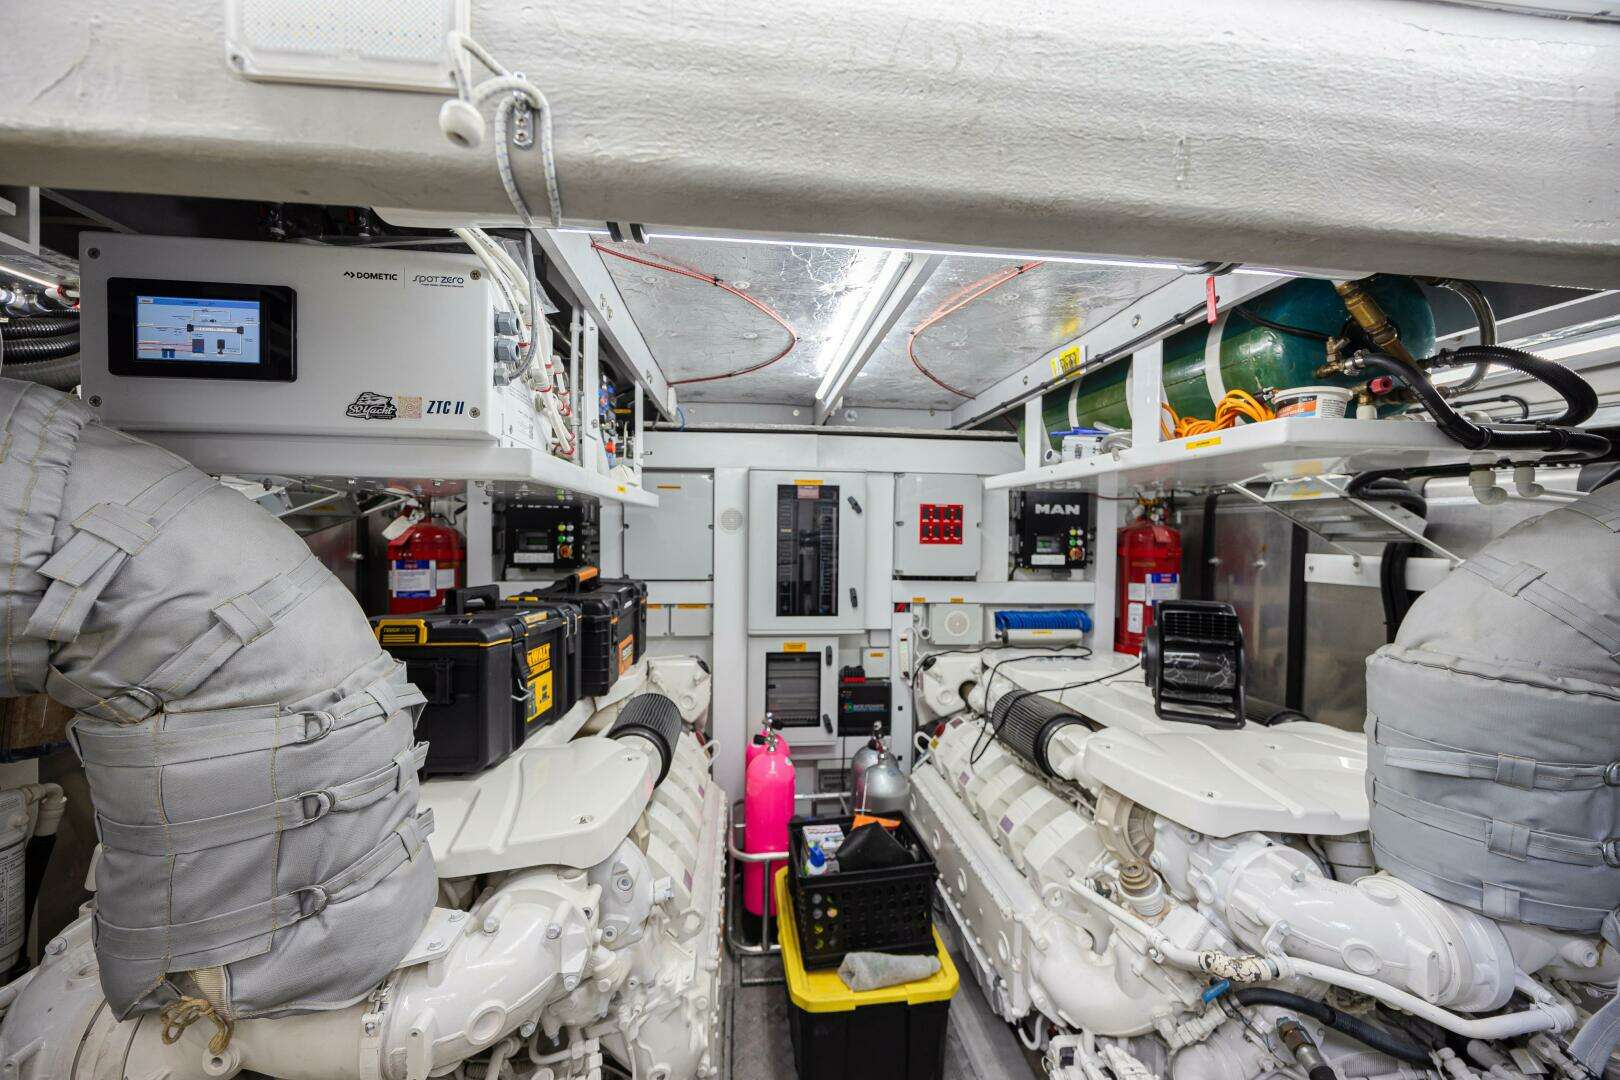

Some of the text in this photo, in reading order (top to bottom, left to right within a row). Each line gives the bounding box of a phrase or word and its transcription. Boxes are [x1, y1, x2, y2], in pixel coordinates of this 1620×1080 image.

[357, 271, 397, 281] DOMETIC
[426, 400, 451, 414] ZTC
[1035, 503, 1080, 515] MAN
